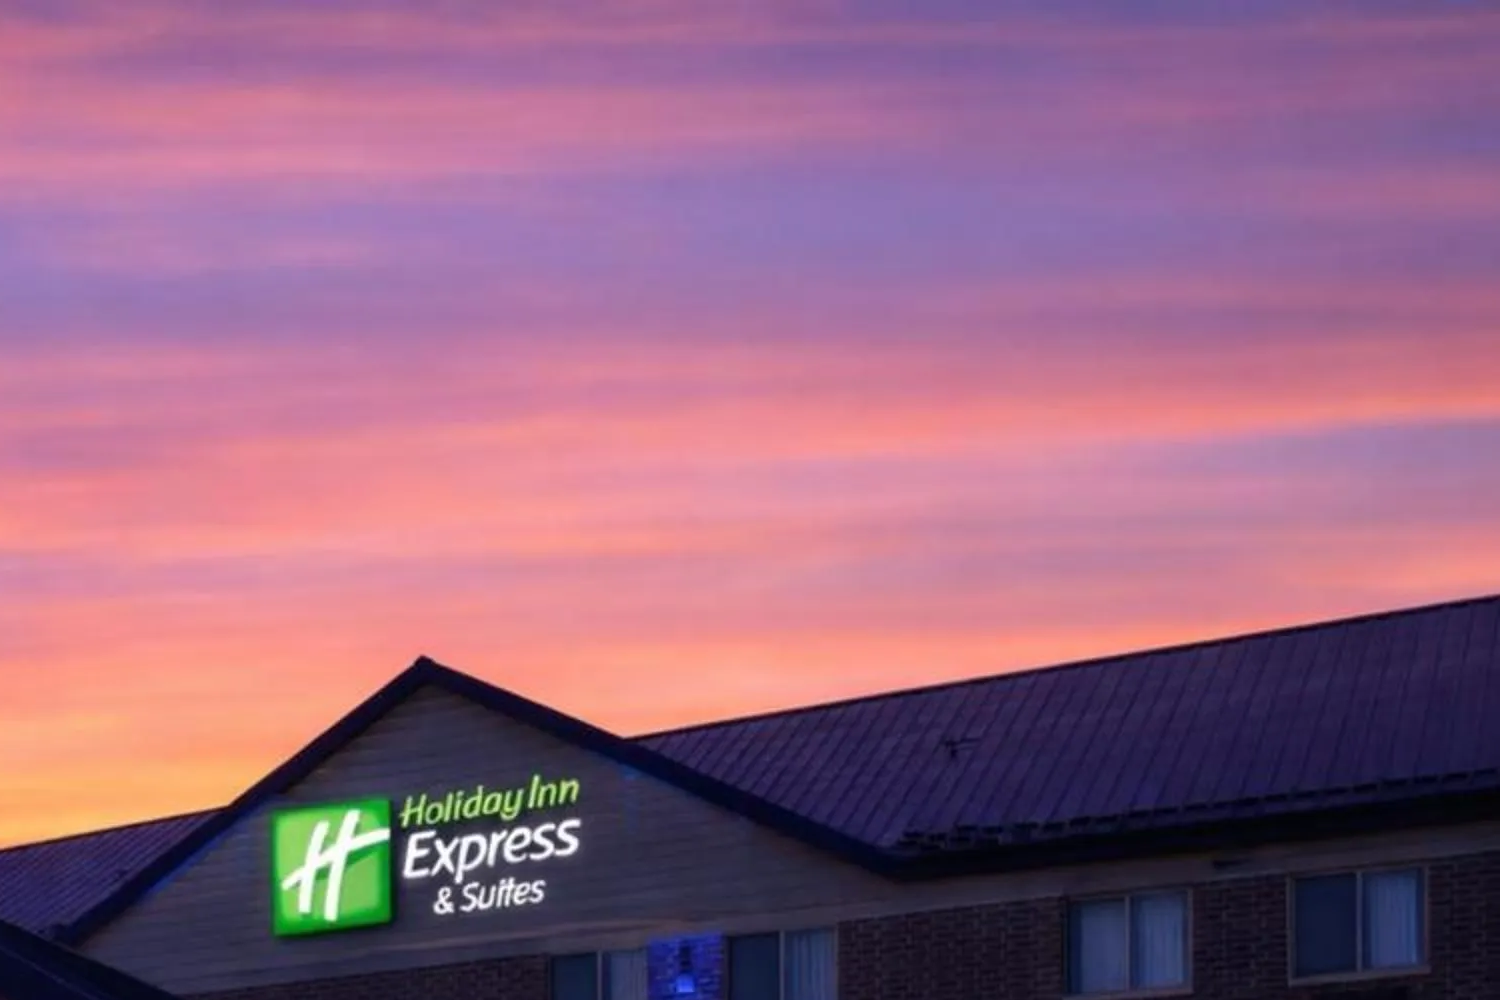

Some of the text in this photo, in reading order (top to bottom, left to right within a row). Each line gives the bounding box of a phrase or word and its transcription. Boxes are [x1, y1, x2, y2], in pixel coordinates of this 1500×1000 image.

[401, 775, 580, 827] Holiday Inn
[403, 816, 581, 884] Express
[433, 876, 546, 914] & Suites
